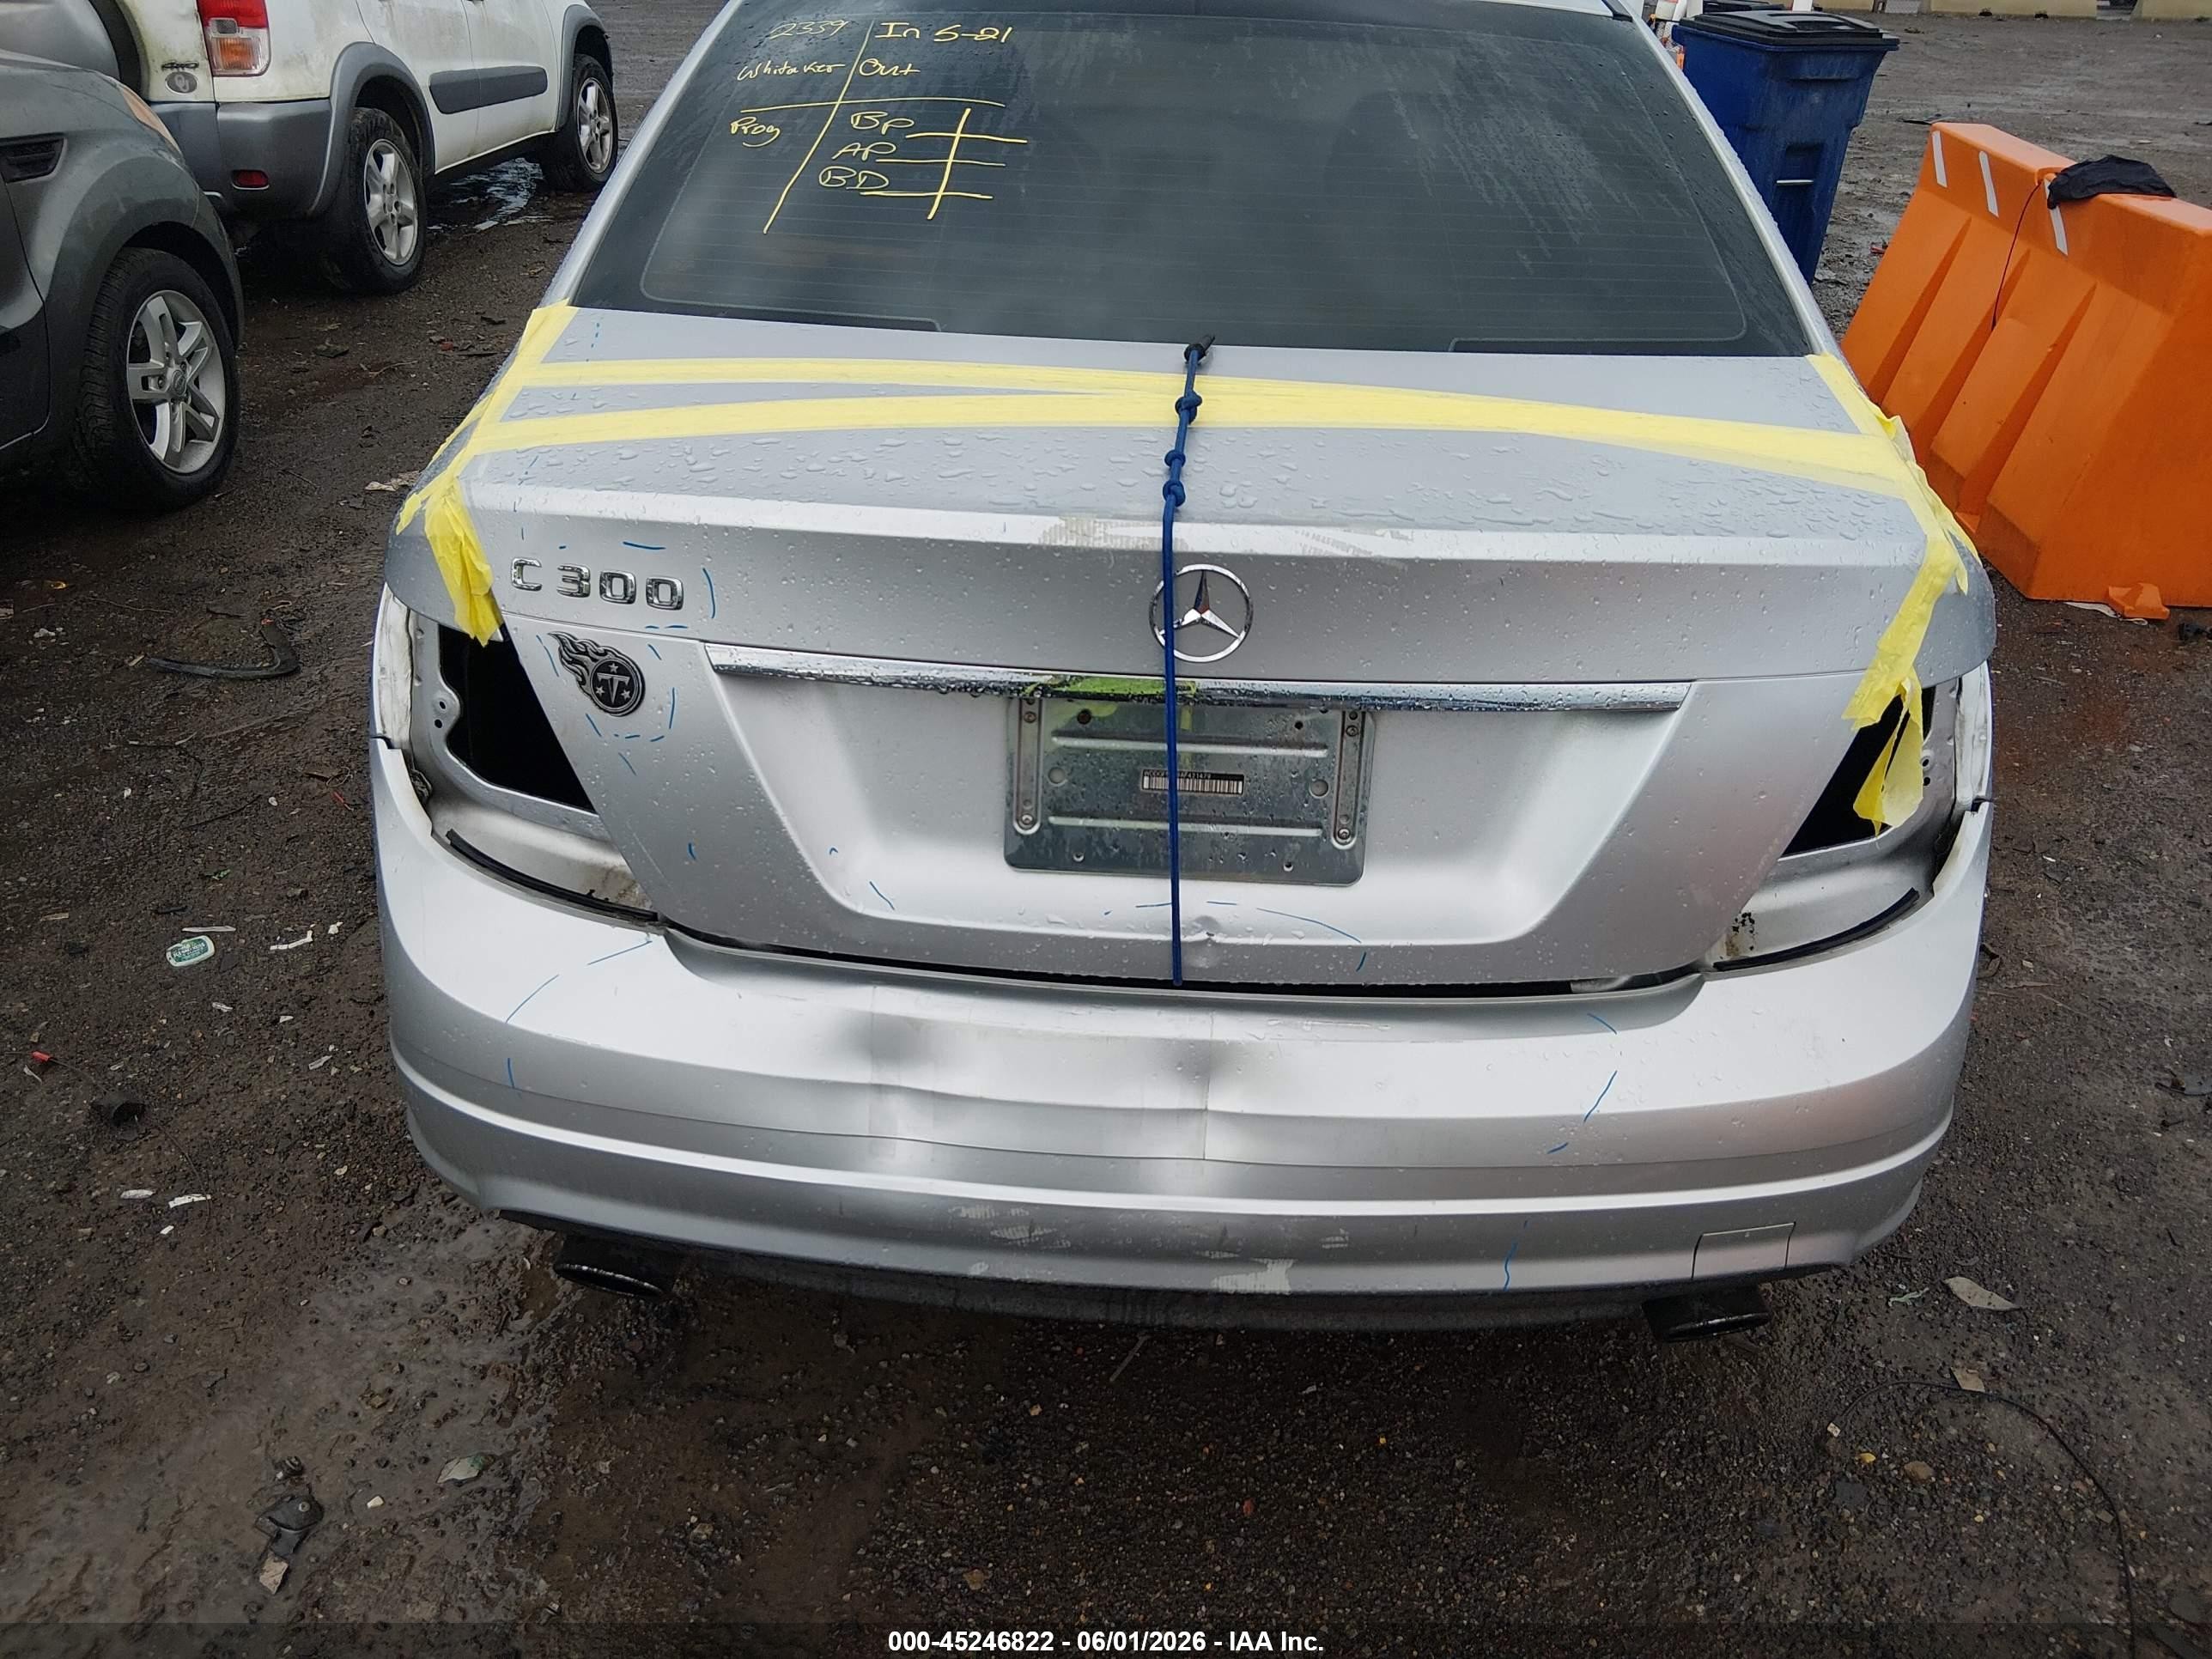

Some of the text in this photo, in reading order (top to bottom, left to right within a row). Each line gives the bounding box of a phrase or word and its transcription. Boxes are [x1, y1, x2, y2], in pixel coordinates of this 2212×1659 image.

[874, 21, 921, 39] In
[859, 58, 921, 76] Out
[818, 165, 890, 190] BD
[510, 557, 684, 611] C 300
